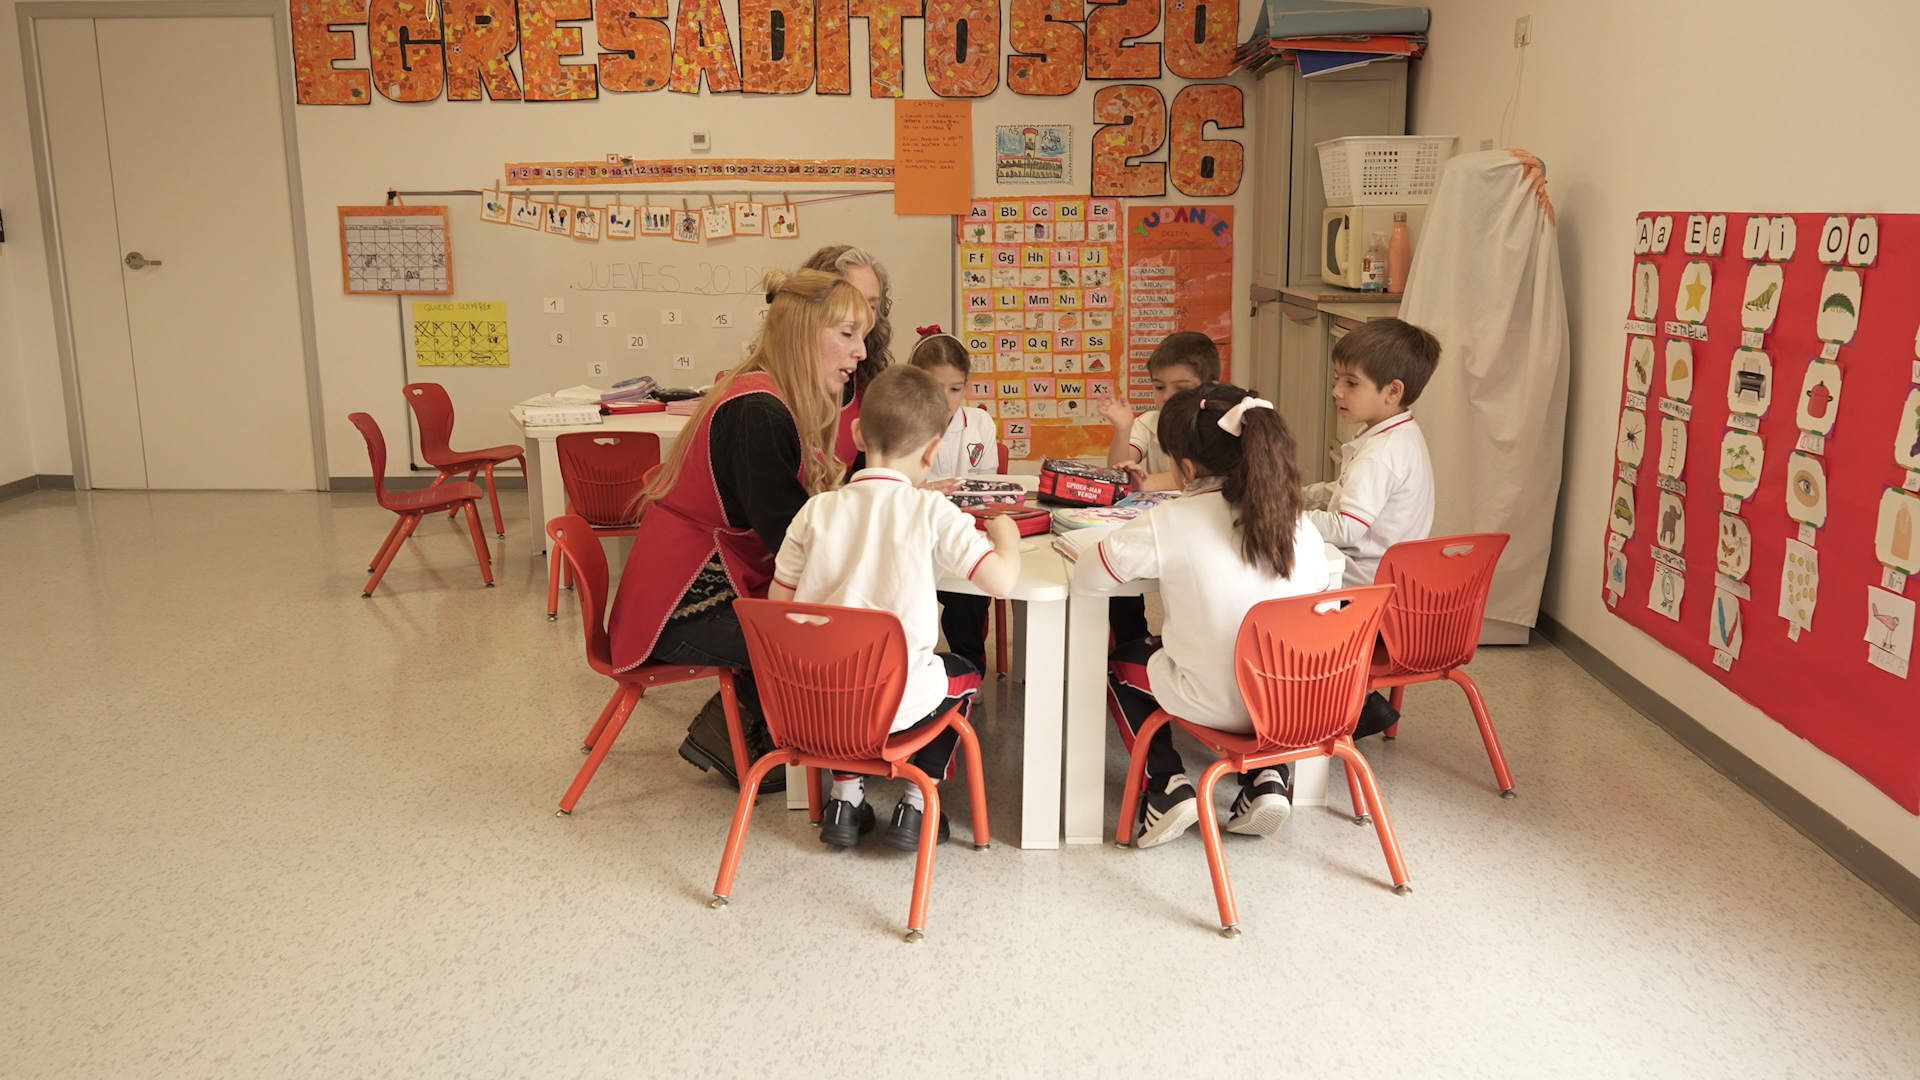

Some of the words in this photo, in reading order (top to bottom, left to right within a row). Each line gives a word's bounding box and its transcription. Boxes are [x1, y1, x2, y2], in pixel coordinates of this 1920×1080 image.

[291, 0, 1086, 105] EGRESADITOS
[1091, 83, 1245, 197] 26
[578, 168, 584, 176] 7
[590, 168, 596, 176] 8
[610, 168, 622, 176] 10
[636, 166, 646, 174] 12
[673, 166, 684, 174] 15
[698, 166, 709, 174] 17
[738, 166, 748, 174] 20
[776, 166, 786, 174] 23
[804, 166, 814, 174] 25
[818, 166, 828, 174] 26
[830, 166, 841, 174] 27
[845, 166, 856, 174] 28
[971, 207, 987, 218] Aa
[1001, 207, 1017, 217] Bb
[1032, 206, 1048, 216] Cc
[1062, 206, 1078, 216] Dd
[1094, 205, 1108, 216] Ee
[998, 252, 1014, 264] Gg
[1028, 252, 1044, 262] Hh
[577, 262, 680, 292] JUEVES
[694, 262, 730, 293] 20
[972, 296, 987, 306] Kk
[1029, 295, 1049, 304] Mm
[1060, 294, 1075, 304] Nn
[550, 300, 557, 310] 1
[602, 315, 609, 325] 5
[669, 312, 675, 322] 3
[716, 314, 728, 324] 15
[556, 334, 563, 344] 8
[632, 337, 644, 347] 20
[1062, 337, 1074, 347] Rr
[1089, 336, 1104, 346] Ss
[970, 340, 987, 349] Oo
[1001, 339, 1016, 350] Pp
[678, 357, 690, 366] 14
[594, 364, 600, 374] 6
[1003, 385, 1018, 394] Uu
[1034, 384, 1048, 393] Vv
[1060, 384, 1081, 393] Ww
[1010, 424, 1024, 434] Zz
[1066, 482, 1102, 494] SPIDER-MAN
[1078, 490, 1098, 500] VENOM
